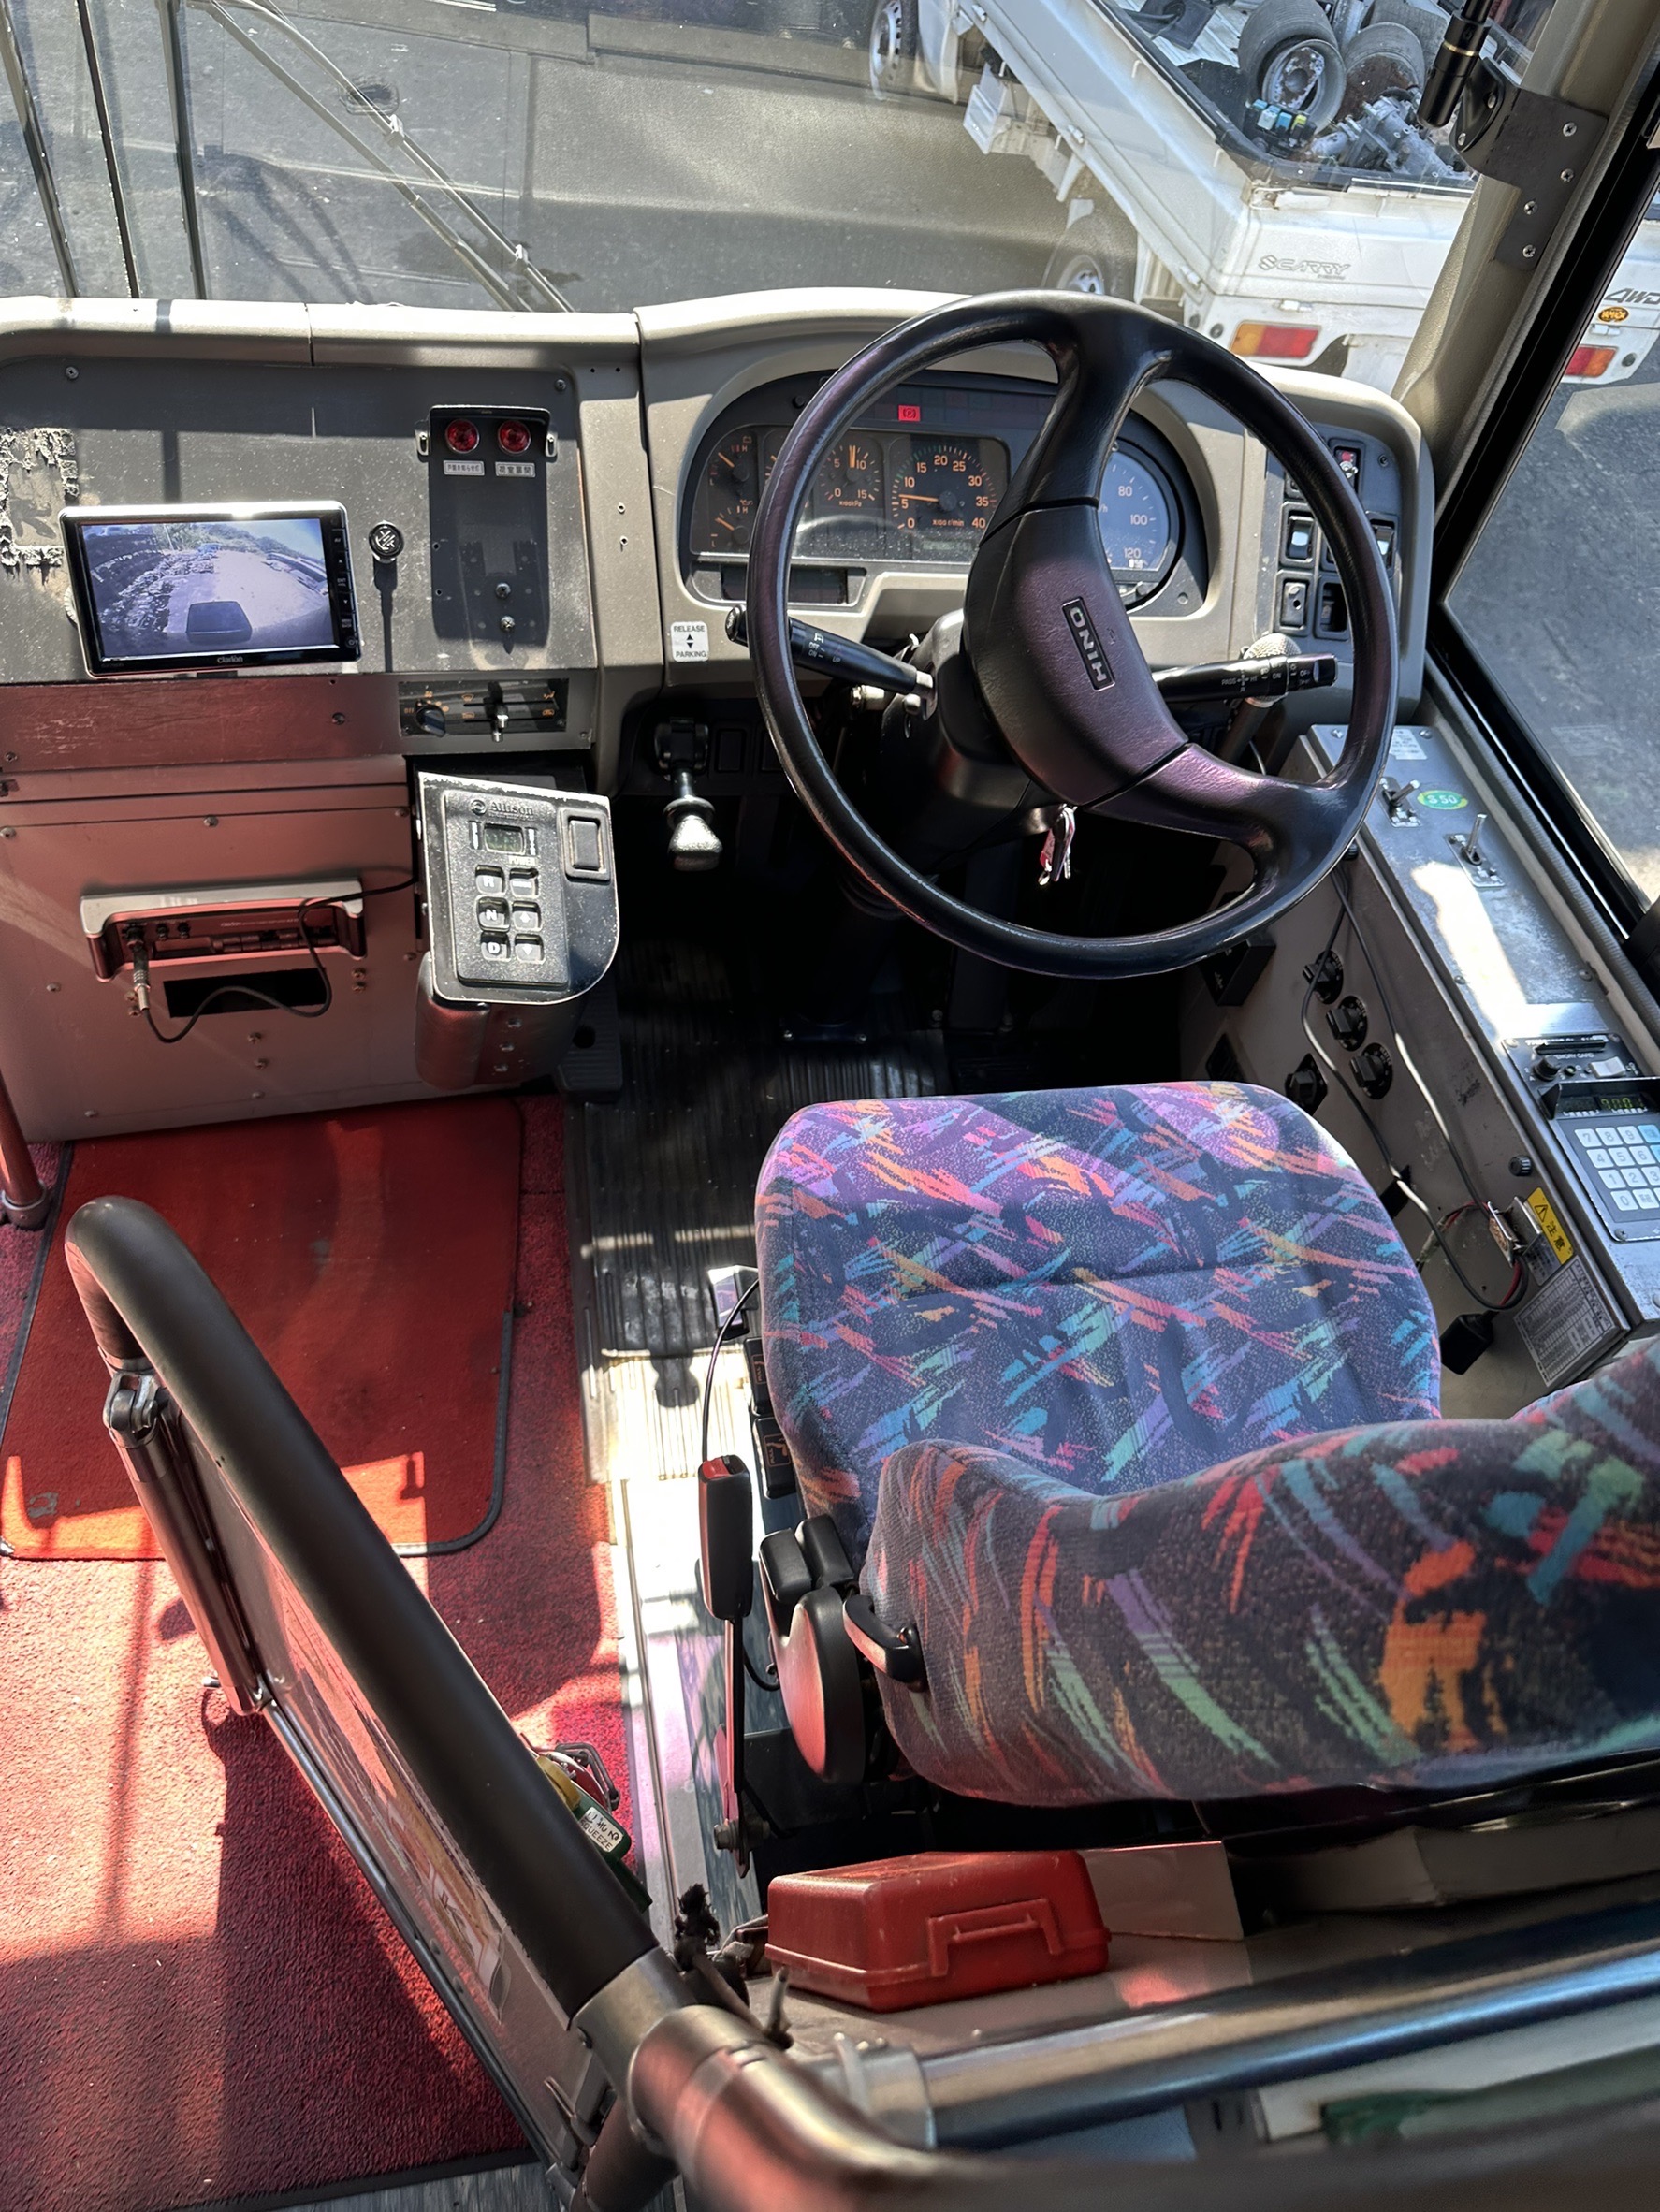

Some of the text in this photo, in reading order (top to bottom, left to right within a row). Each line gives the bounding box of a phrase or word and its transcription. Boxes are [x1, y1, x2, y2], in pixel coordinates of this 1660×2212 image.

[856, 460, 866, 470] 10
[934, 455, 948, 466] 20
[916, 462, 927, 473] 15
[953, 461, 967, 472] 25
[904, 477, 915, 488] 10
[968, 475, 983, 487] 30
[834, 488, 841, 497] 0
[857, 489, 867, 499] 15
[1118, 486, 1133, 497] 80
[901, 499, 909, 509] 5
[975, 496, 989, 507] 35
[907, 517, 915, 529] 0
[971, 517, 986, 529] 40
[1130, 514, 1148, 525] 100
[1124, 547, 1142, 559] 120
[1070, 607, 1107, 682] HINO
[1439, 795, 1458, 805] 50
[489, 801, 534, 817] Allison
[483, 876, 495, 888] R
[486, 909, 498, 921] N
[488, 941, 501, 954] D
[1582, 1133, 1591, 1142] 7
[1604, 1131, 1614, 1142] 8
[1624, 1130, 1635, 1140] 9
[1596, 1154, 1605, 1162] 4
[1617, 1152, 1625, 1161] 5
[1638, 1150, 1647, 1160] 6
[1609, 1174, 1617, 1185] 1
[1628, 1172, 1638, 1183] 2
[1650, 1171, 1659, 1181] 3
[1620, 1196, 1629, 1206] 0
[1546, 1219, 1566, 1252] 注意
[580, 1819, 614, 1851] SQUEEZE
